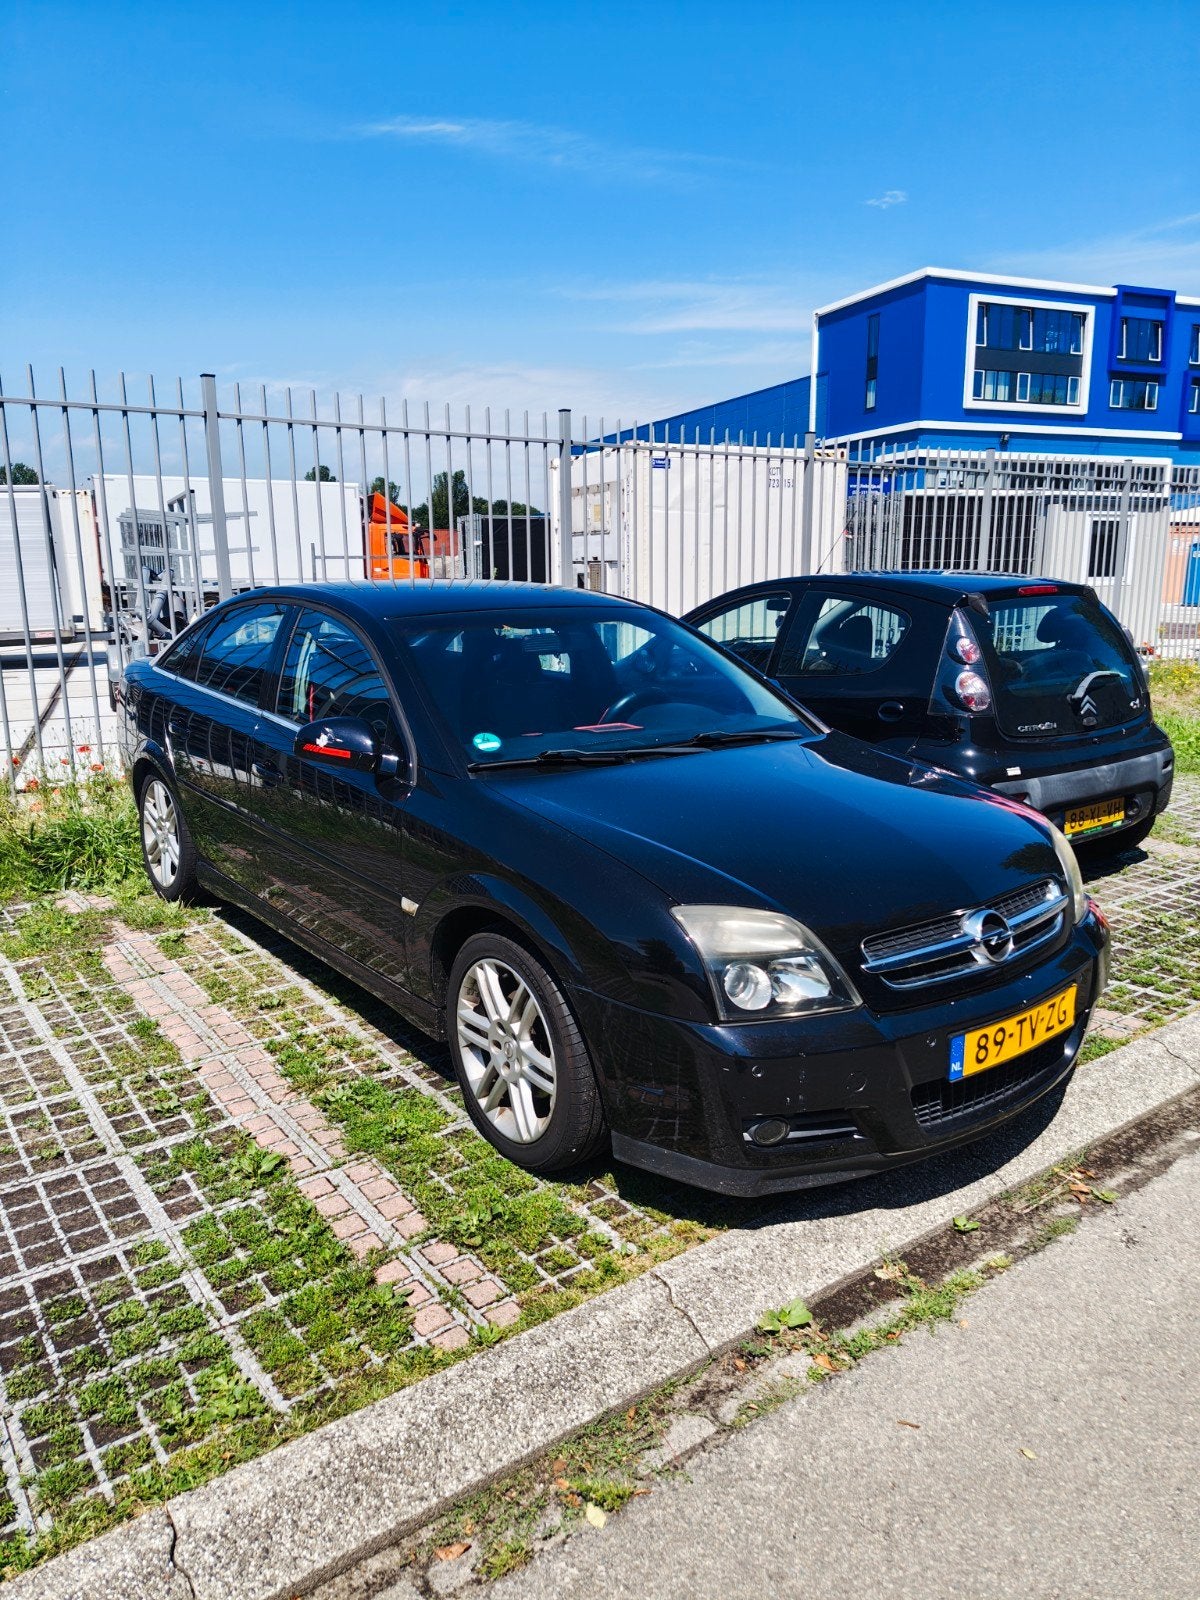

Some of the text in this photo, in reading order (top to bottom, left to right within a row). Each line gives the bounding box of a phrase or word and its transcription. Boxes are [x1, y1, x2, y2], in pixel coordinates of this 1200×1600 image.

[1069, 800, 1121, 830] 88-XL-VH
[975, 995, 1067, 1065] 89-TV-ZG
[951, 1061, 963, 1073] NL
